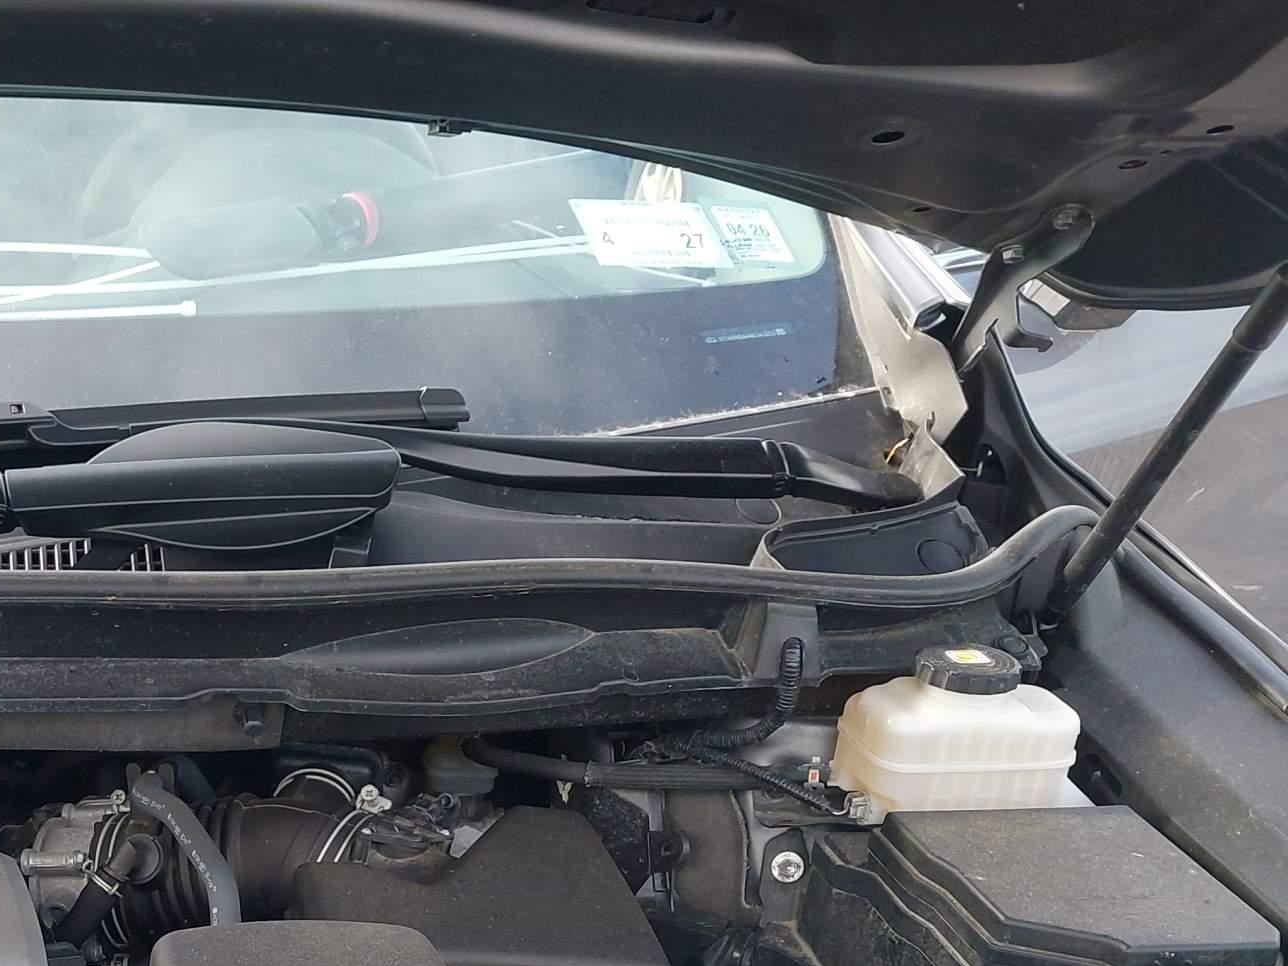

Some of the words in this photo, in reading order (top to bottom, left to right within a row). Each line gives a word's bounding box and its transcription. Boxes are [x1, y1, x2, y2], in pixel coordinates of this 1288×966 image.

[726, 222, 746, 236] 04
[602, 232, 615, 245] 4
[680, 233, 704, 248] 27
